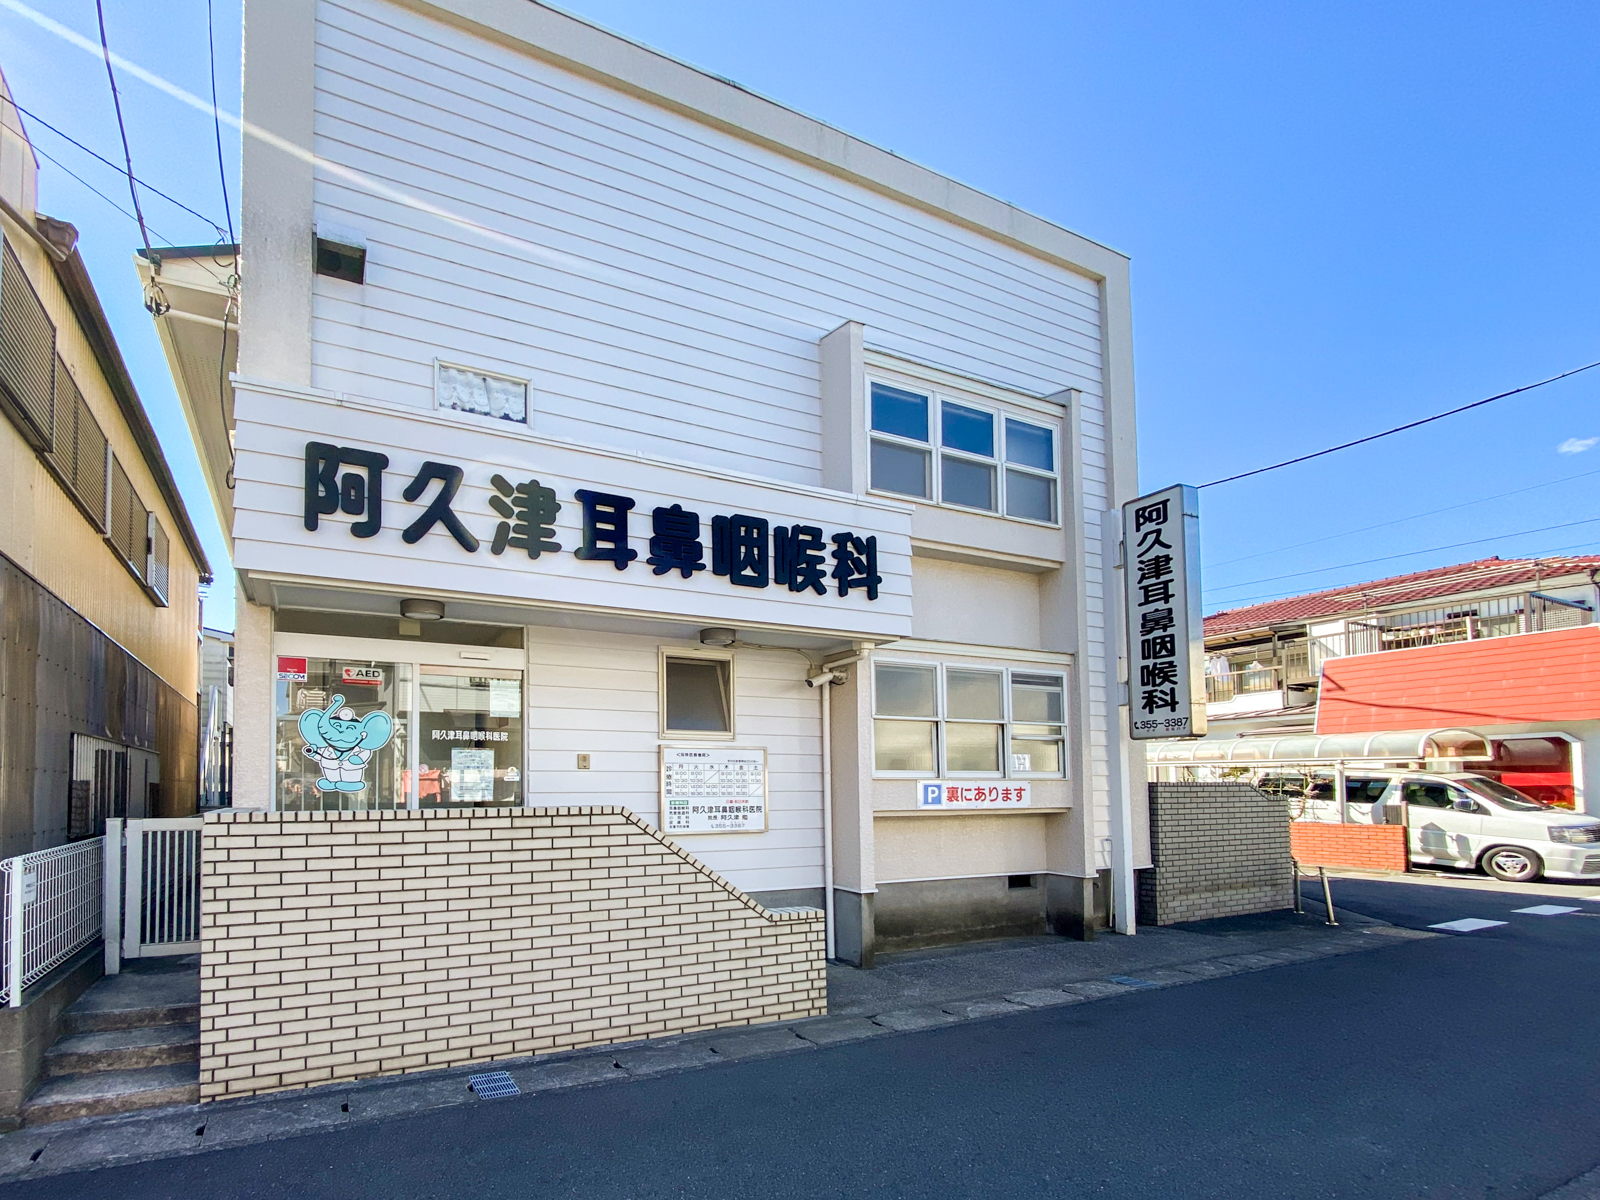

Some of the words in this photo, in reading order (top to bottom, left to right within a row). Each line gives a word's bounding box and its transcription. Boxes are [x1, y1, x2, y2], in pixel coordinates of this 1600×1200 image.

[303, 440, 882, 601] 阿久津耳鼻咽喉科
[1134, 498, 1180, 715] 阿久津耳鼻咽喉科
[356, 669, 380, 678] AED
[1140, 717, 1189, 730] 355-3387
[431, 729, 509, 742] 阿久津耳鼻咽喉科医院
[945, 786, 1026, 802] 裏にあります
